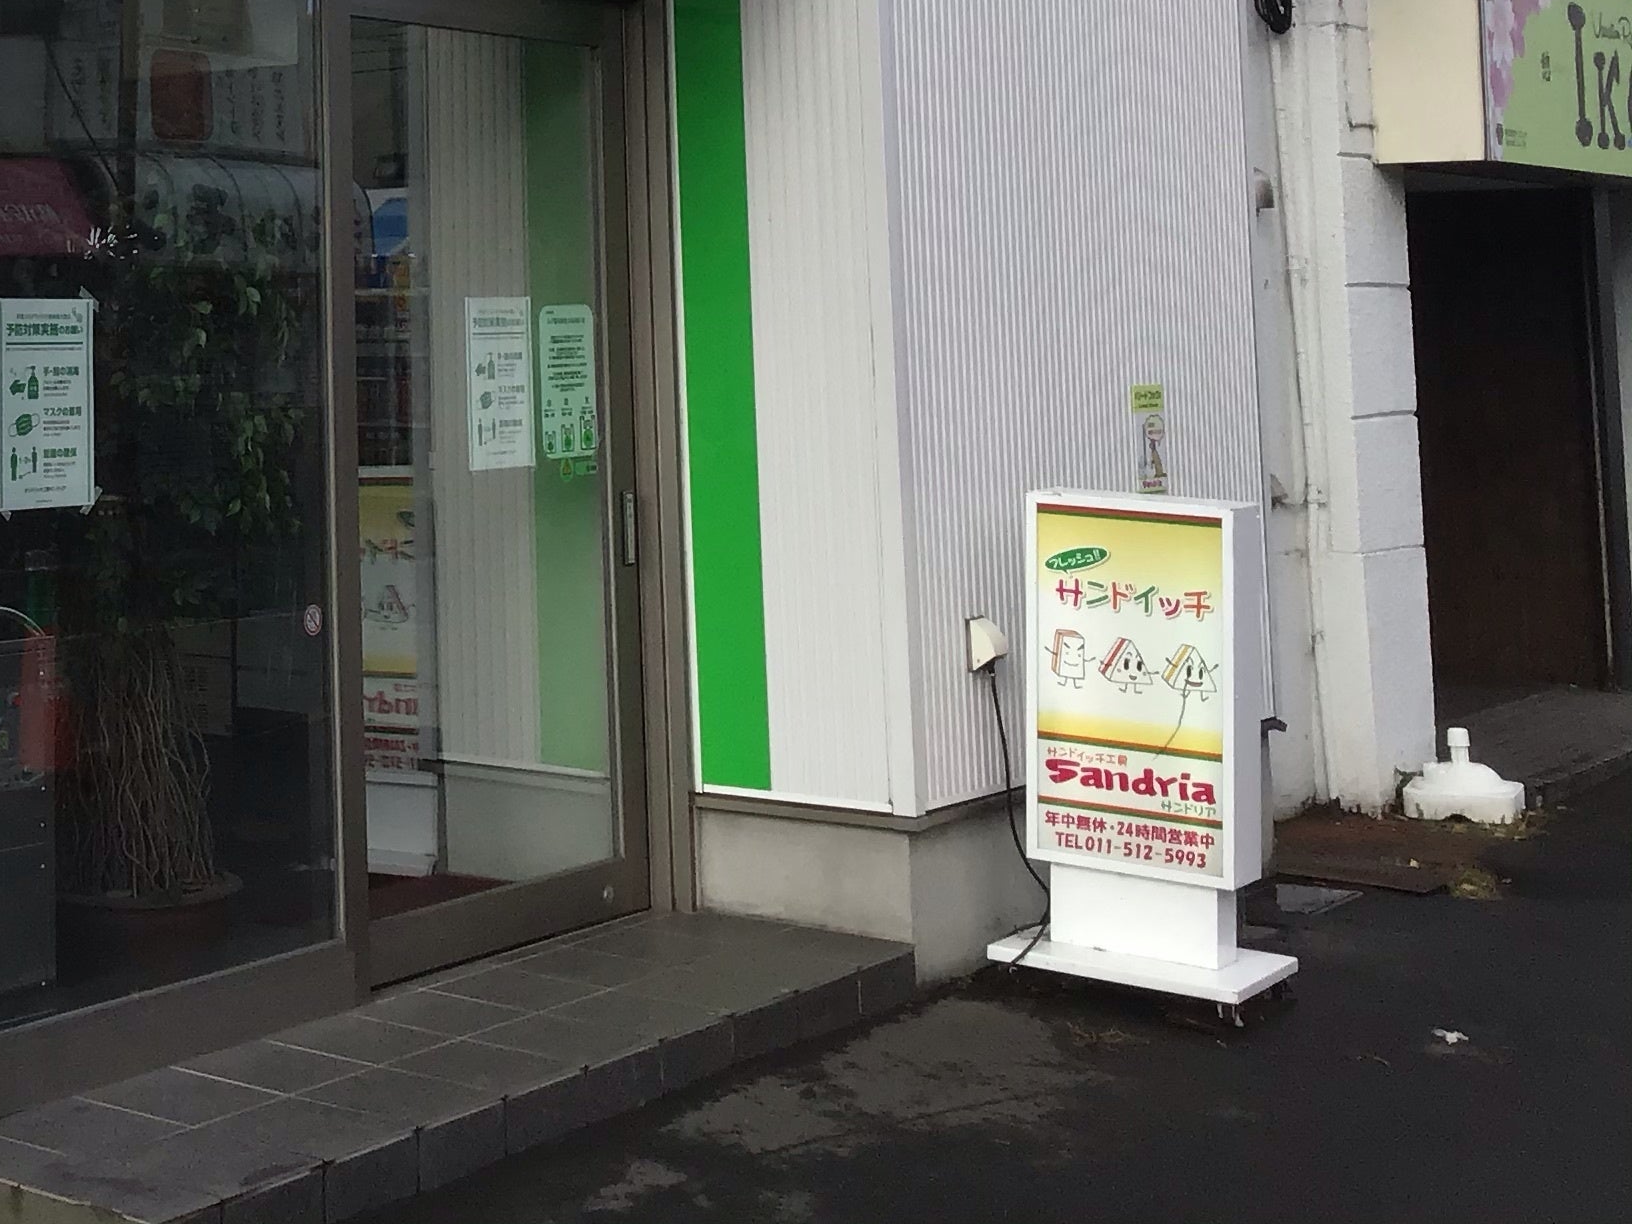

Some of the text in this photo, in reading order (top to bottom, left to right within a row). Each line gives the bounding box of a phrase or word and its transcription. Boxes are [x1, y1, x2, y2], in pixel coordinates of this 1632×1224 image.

[1055, 578, 1212, 619] サンドイッチ
[1045, 758, 1217, 805] Sandria
[1160, 800, 1217, 818] サンドリア
